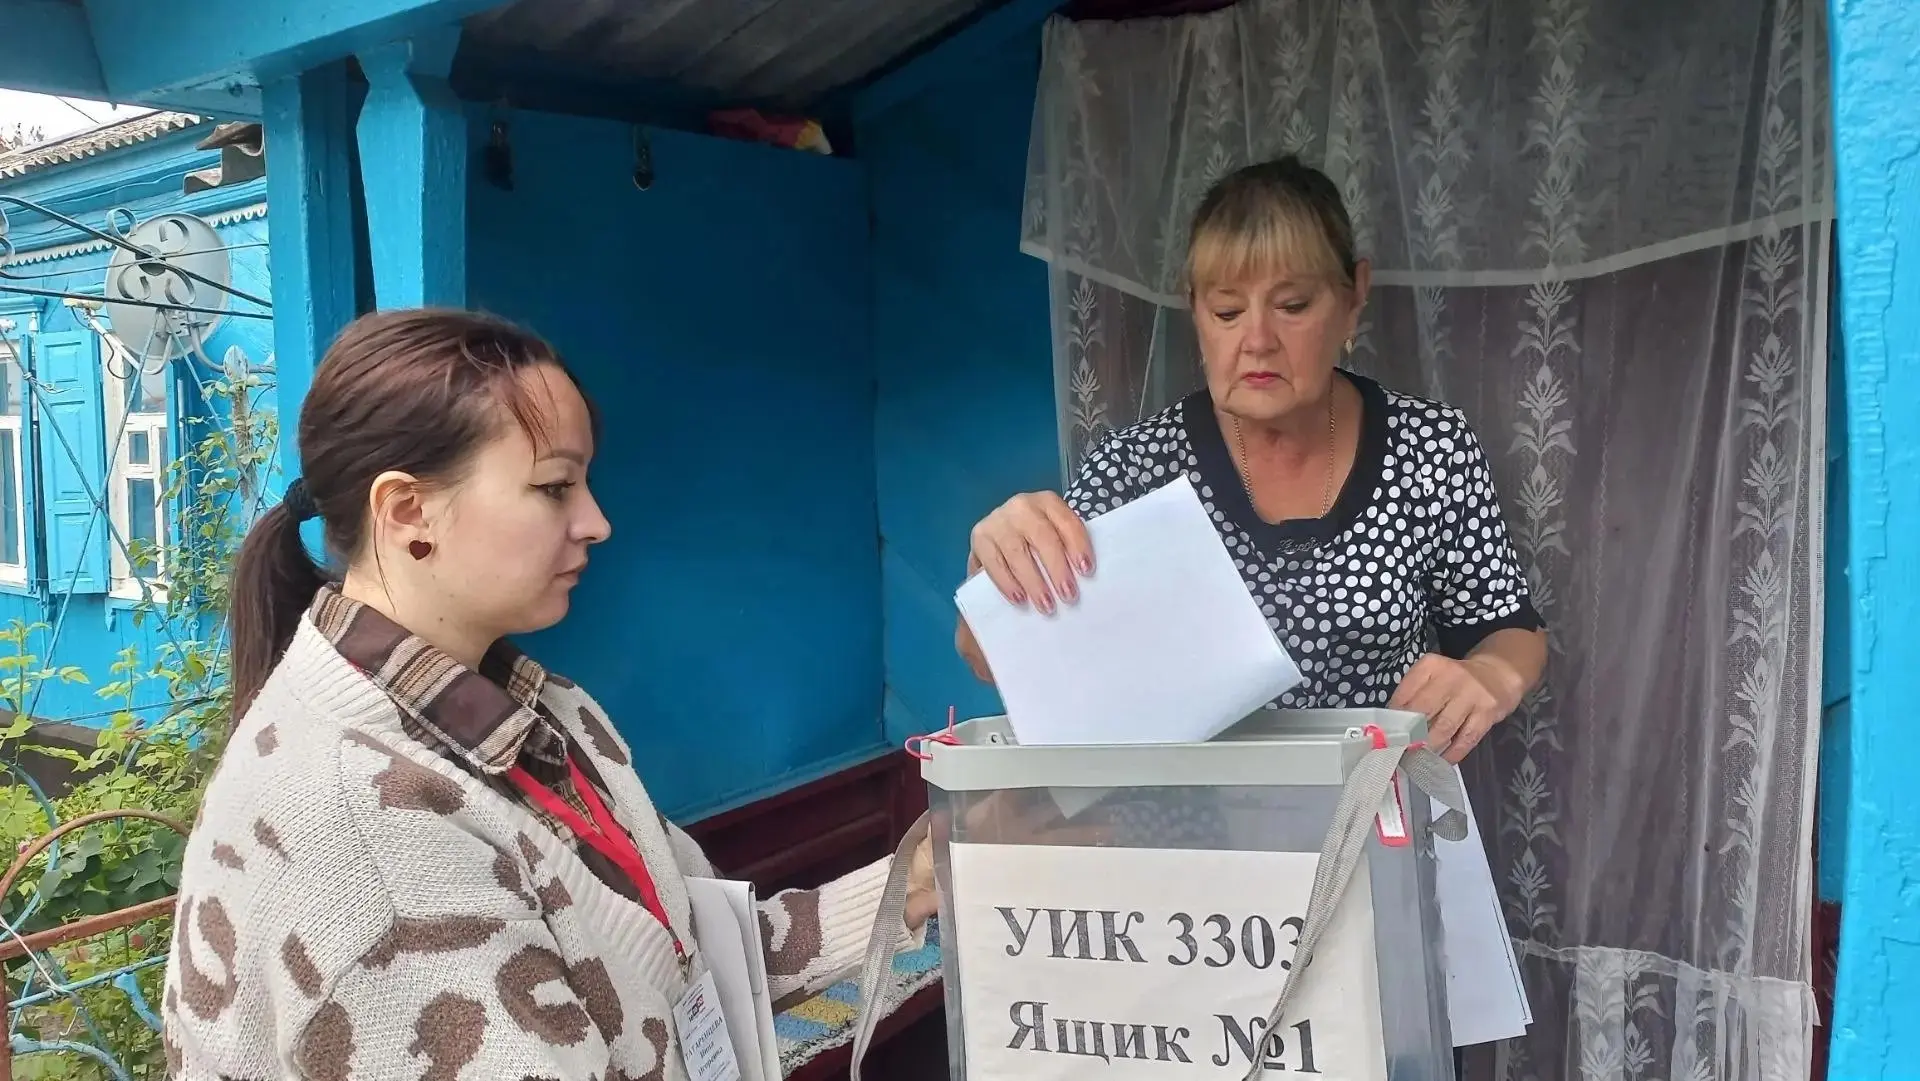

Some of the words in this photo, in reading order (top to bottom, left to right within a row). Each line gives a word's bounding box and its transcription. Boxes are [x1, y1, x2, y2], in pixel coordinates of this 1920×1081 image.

[994, 906, 1149, 963] УИК
[1006, 1000, 1193, 1065] Ящик
[1212, 1013, 1322, 1073] №1
